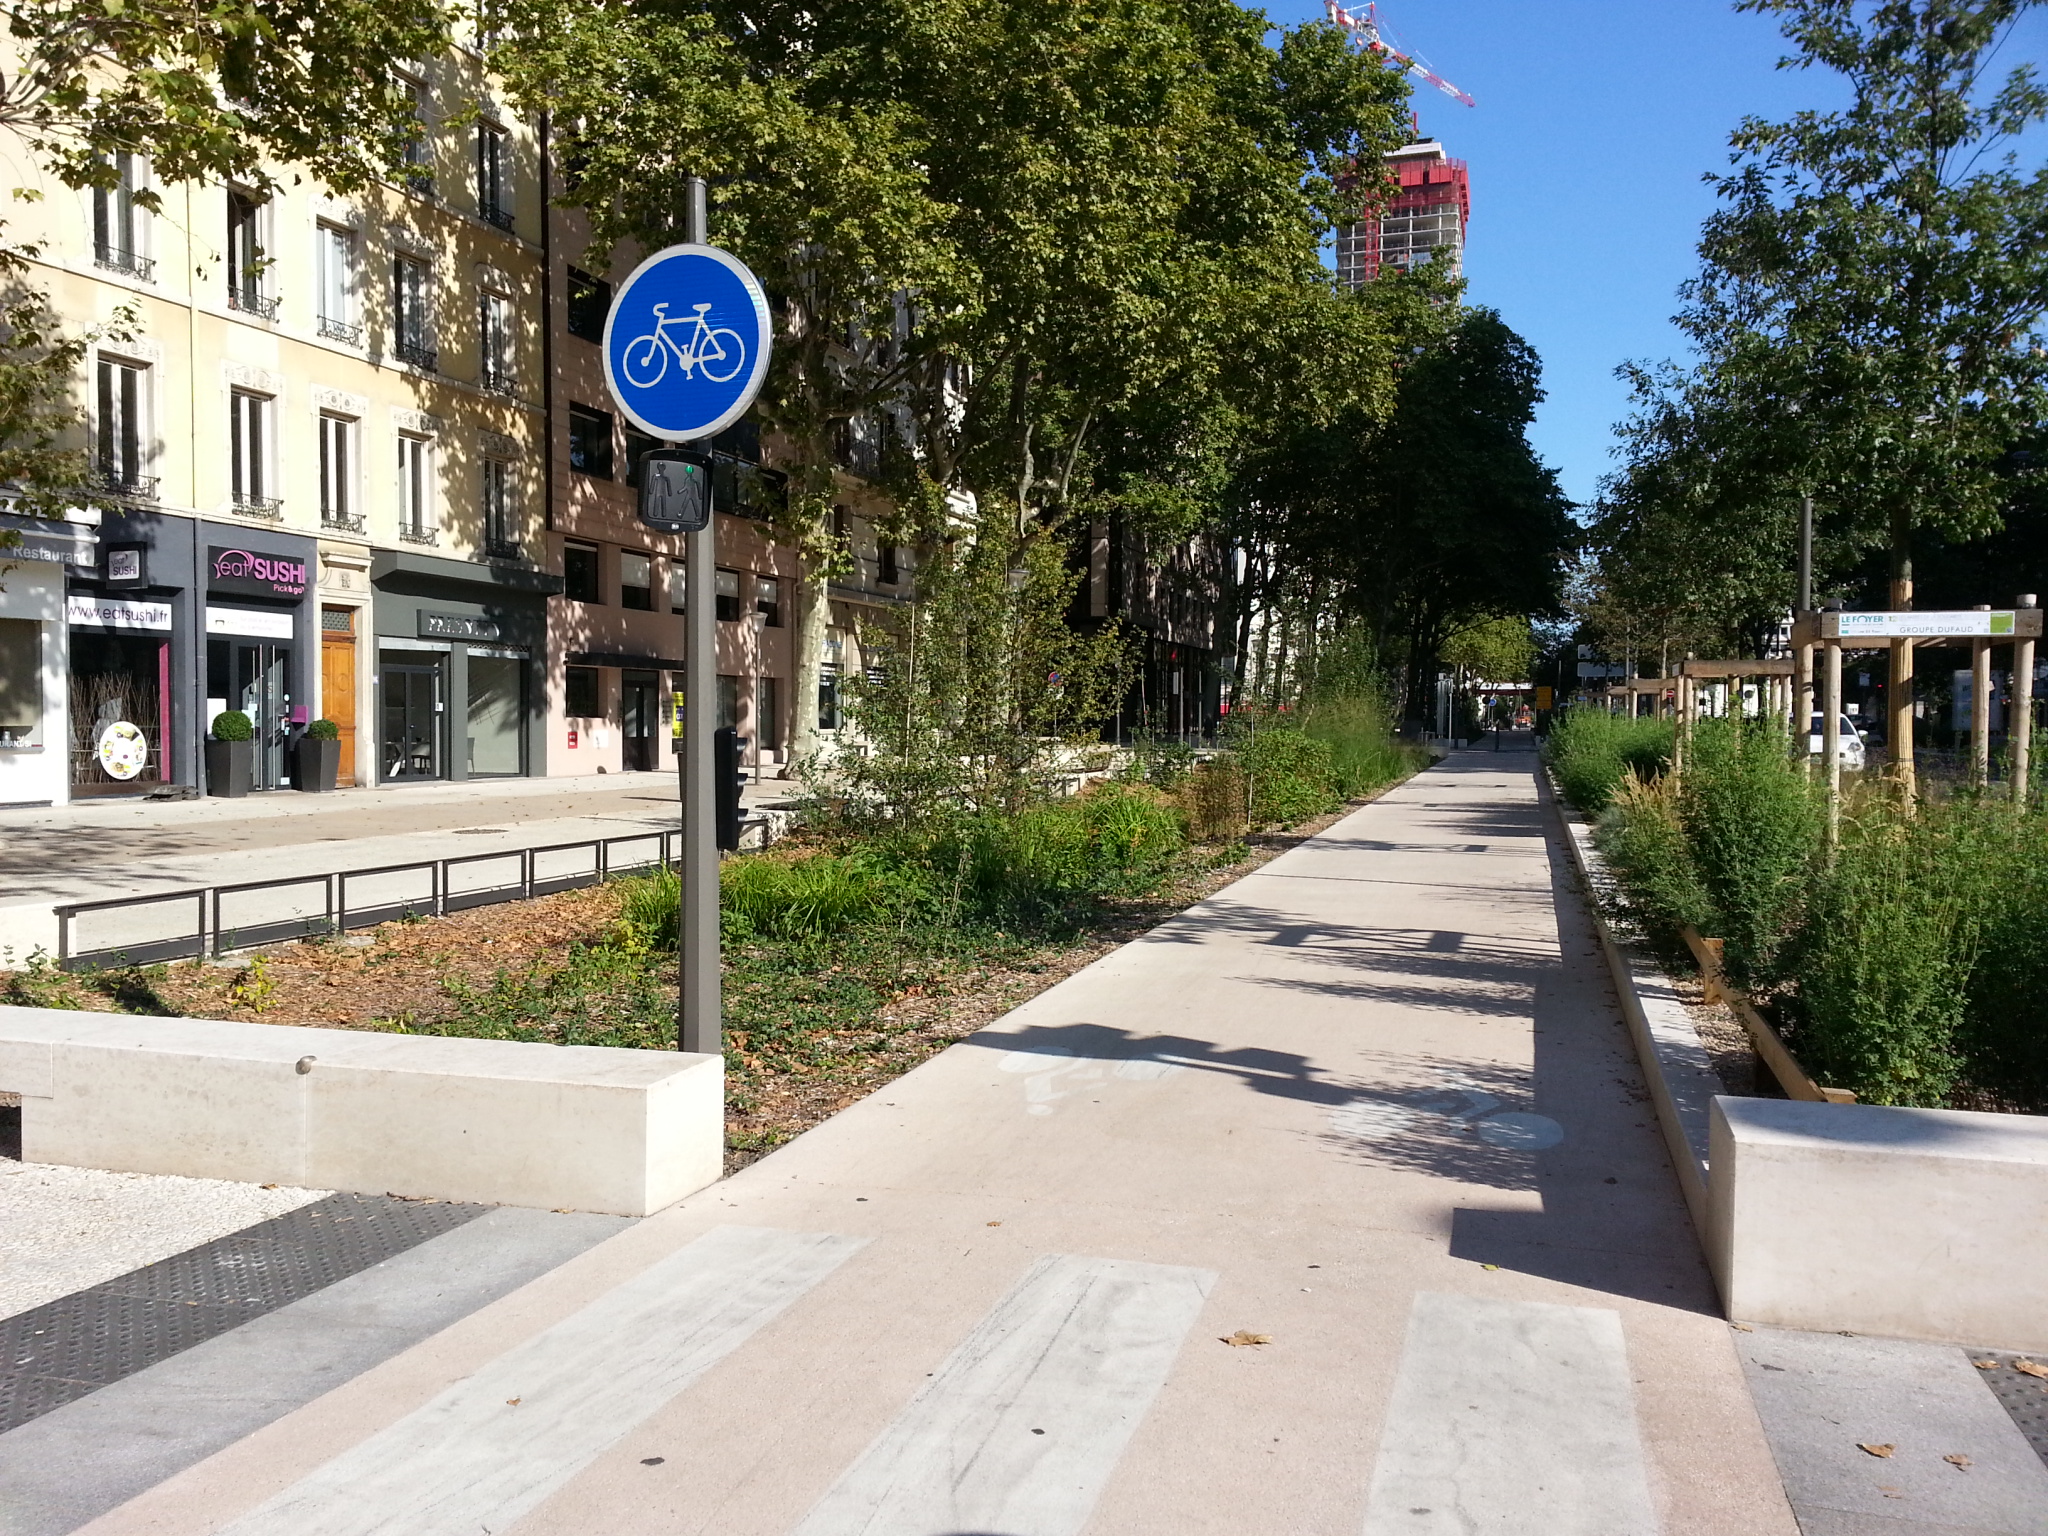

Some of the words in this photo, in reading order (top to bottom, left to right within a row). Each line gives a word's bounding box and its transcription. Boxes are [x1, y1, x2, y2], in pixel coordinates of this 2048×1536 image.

[13, 546, 87, 564] Restaurant
[113, 565, 137, 576] SUSHI
[254, 558, 306, 584] SUSHI
[68, 606, 168, 622] www.eatsushi.fr
[1841, 615, 1850, 623] LE
[1852, 614, 1884, 623] FOYER
